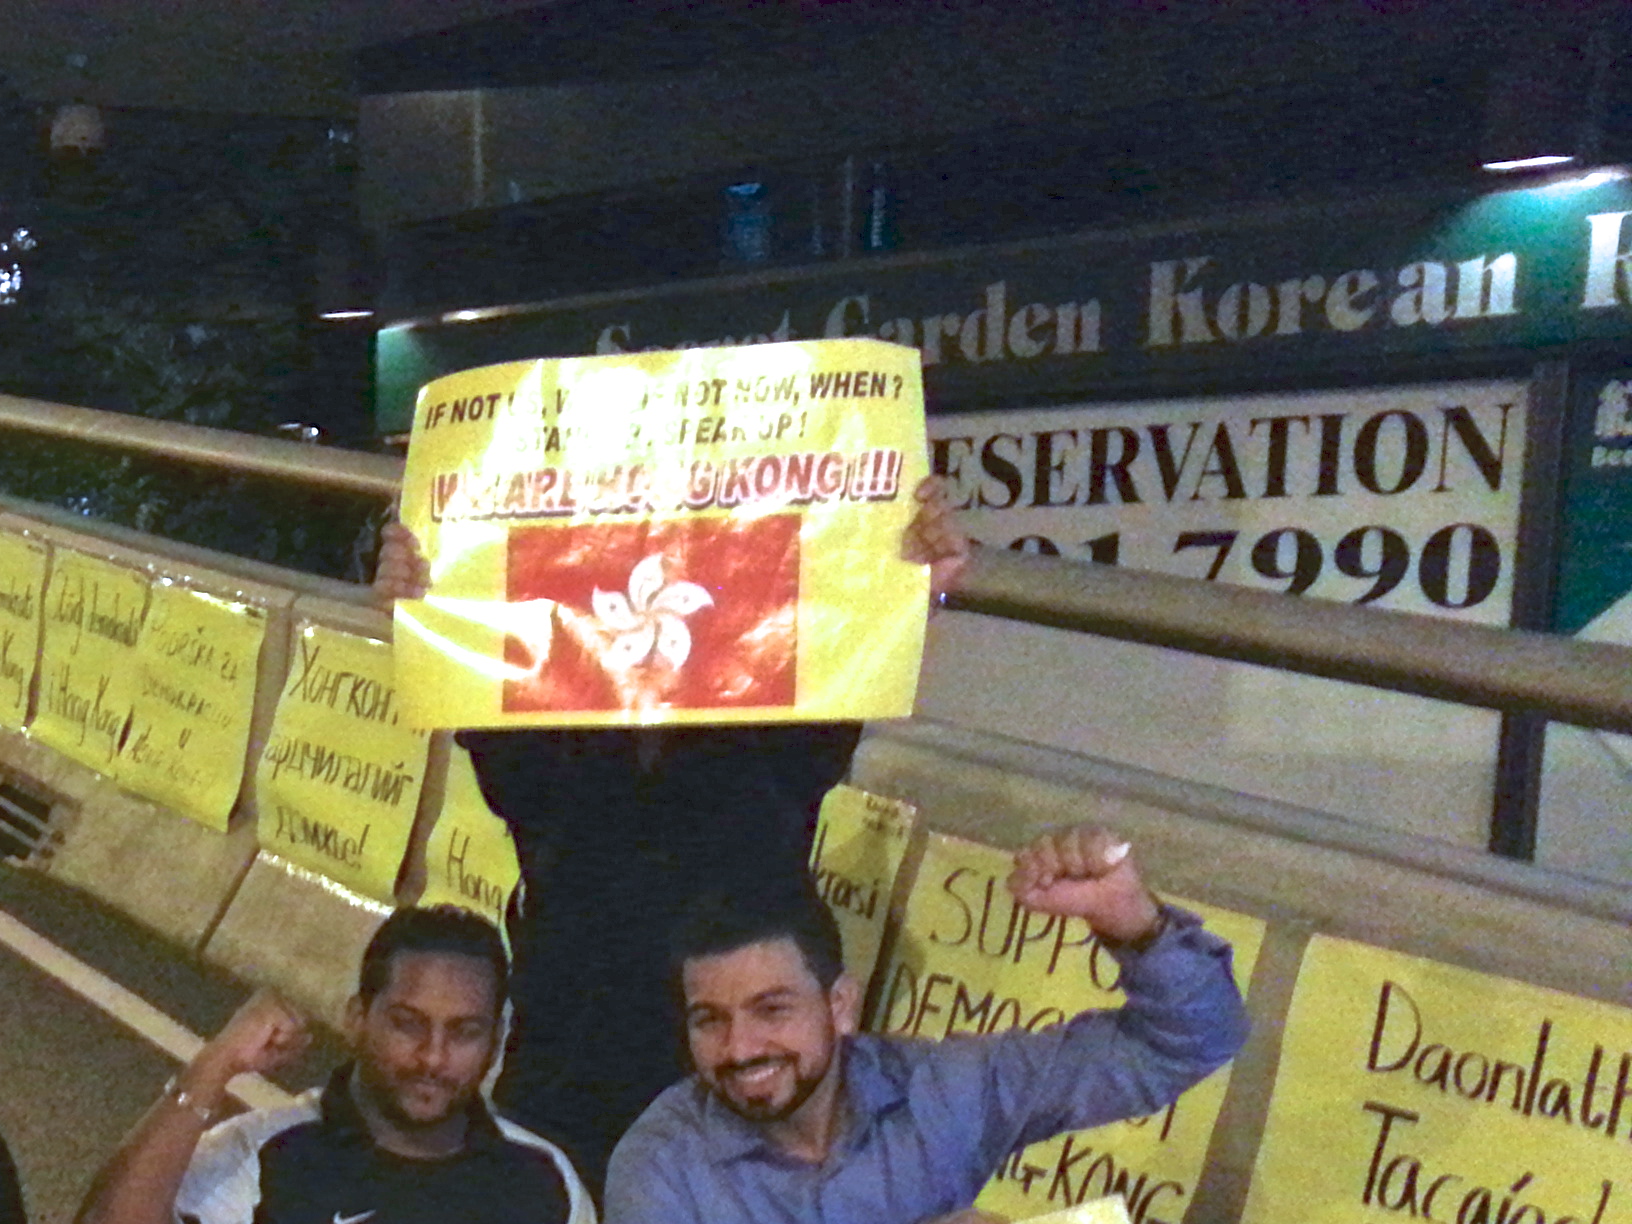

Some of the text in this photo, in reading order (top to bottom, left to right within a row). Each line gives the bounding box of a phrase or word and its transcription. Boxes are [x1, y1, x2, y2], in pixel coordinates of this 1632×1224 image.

[1145, 252, 1519, 347] Korean
[425, 402, 447, 430] IF
[450, 393, 502, 424] NOT
[810, 371, 887, 401] WHEN
[718, 451, 848, 507] KONG
[931, 403, 1515, 513] ESERVATION
[928, 866, 1121, 993] SUPPO
